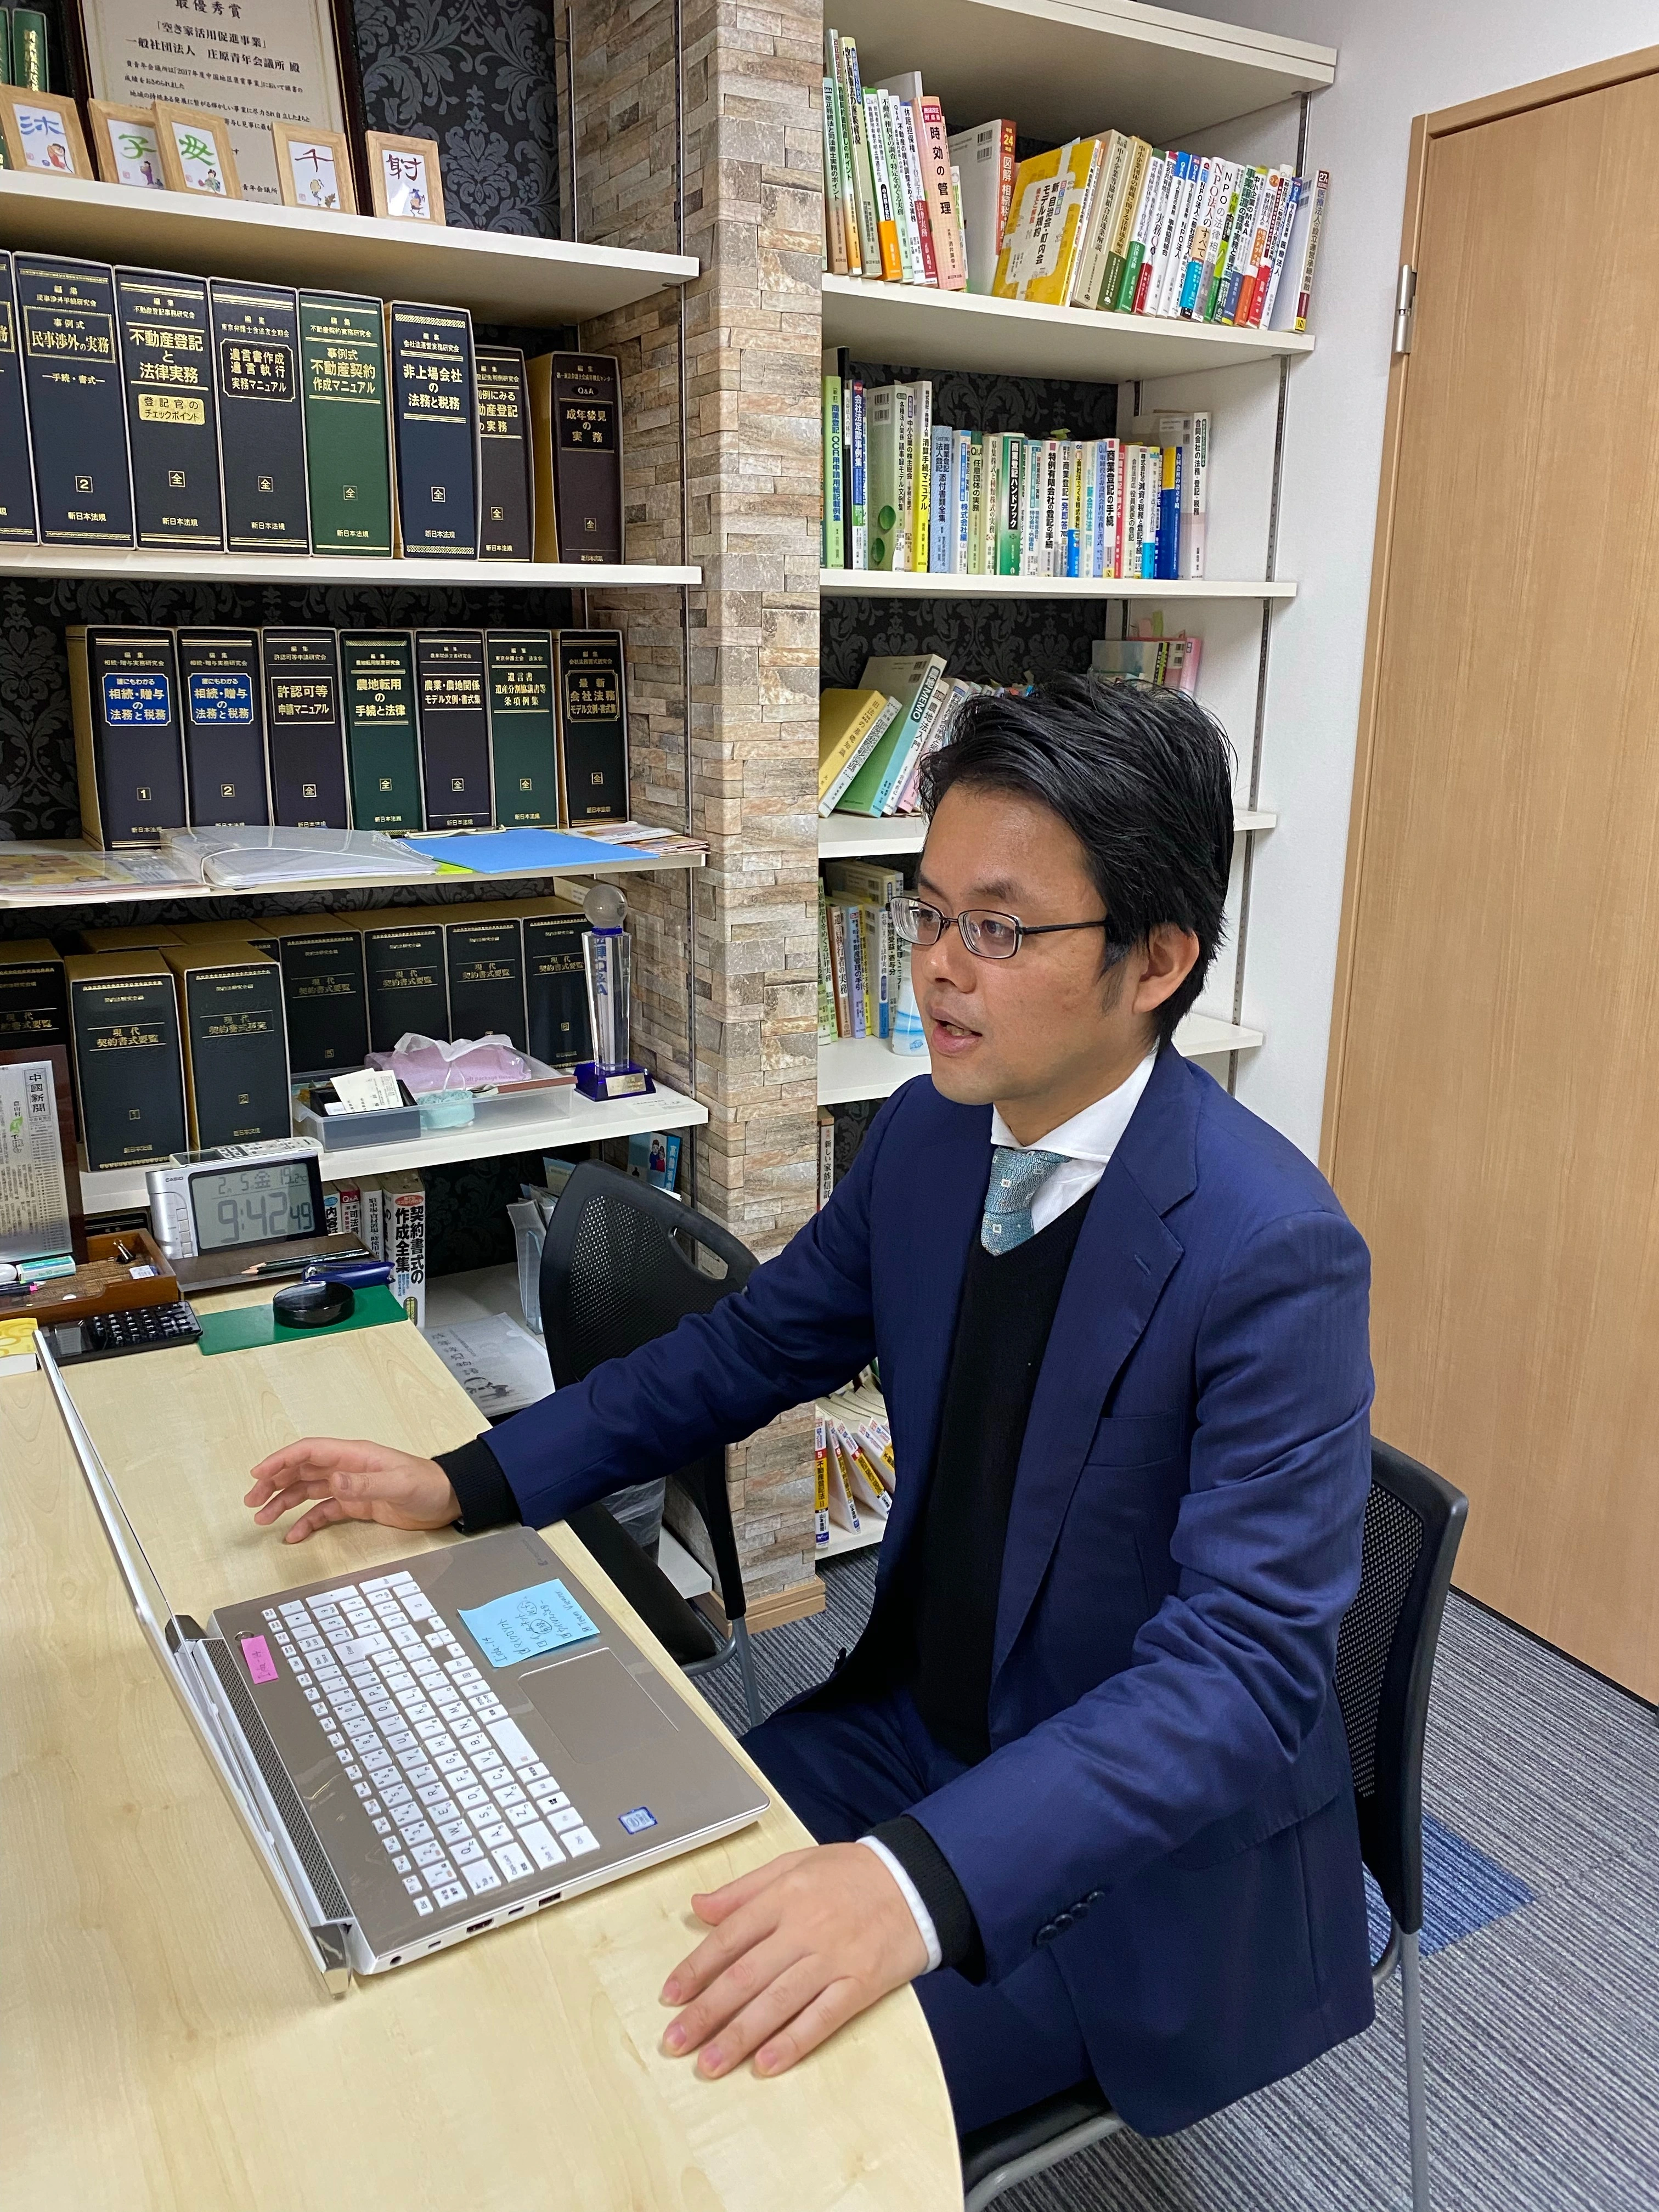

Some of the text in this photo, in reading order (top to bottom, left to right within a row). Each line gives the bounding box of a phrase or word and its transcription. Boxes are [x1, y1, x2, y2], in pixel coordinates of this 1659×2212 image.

[125, 37, 195, 57] 一般社団法人
[207, 49, 285, 71] 庄原青年会議所
[930, 126, 952, 215] 時効の管理
[1003, 157, 1012, 182] 図解
[1175, 222, 1187, 259] NPO法人
[1274, 241, 1287, 276] 医療法人
[54, 318, 85, 329] 事例式
[32, 330, 109, 354] 民事渉外の実務
[130, 329, 204, 351] 不動産登記
[163, 351, 174, 363] と
[230, 348, 285, 364] 遺言書作成
[328, 347, 358, 360] 事例式
[140, 363, 199, 383] 法律実務
[230, 362, 285, 379] 遺言執行
[311, 359, 375, 379] 不動産契約
[403, 364, 462, 382] 非上場会社
[232, 378, 287, 392] 実務マニュアル
[313, 377, 375, 394] 作成マニュアル
[428, 382, 439, 393] の
[144, 397, 198, 410] 登記官の
[408, 395, 460, 410] 法務と税務
[145, 409, 200, 422] チェックポイント
[567, 409, 606, 421] 成年後見
[573, 431, 603, 443] 実務
[921, 438, 929, 511] 清算手続マニュアル
[972, 459, 980, 512] 任意団体の実務
[1009, 443, 1019, 528] 商業登記ハンドブック
[1106, 450, 1115, 527] 商業登記の手続
[1045, 453, 1056, 549] 特例有限会社の登記の手続
[68, 512, 106, 522] 新日本法規
[162, 517, 199, 527] 新日本法規
[251, 521, 285, 531] 新日本法規
[337, 529, 369, 538] 新日本法規
[425, 530, 455, 539] 新日本法規
[507, 673, 533, 682] 遺言書
[277, 685, 328, 698] 許認可等
[357, 679, 402, 691] 農地転用
[425, 680, 480, 691] 農業・農地関係
[495, 684, 546, 694] 遺産分割協議書等
[109, 689, 165, 700] 相続・贈与
[194, 689, 248, 699] 相続・贈与
[375, 693, 385, 702] の
[425, 693, 481, 704] モデル文例・書式集
[571, 691, 615, 702] 会社法務
[504, 697, 539, 706] 条項例集
[111, 709, 166, 720] 法務と税務
[195, 708, 249, 719] 法務と税務
[278, 704, 329, 715] 申請マニュアル
[356, 705, 406, 716] 手続と法律
[571, 704, 617, 714] モデル文例・書式集
[911, 702, 938, 752] 農地法入門
[224, 1015, 249, 1023] 現代
[112, 1027, 140, 1036] 現代
[29, 1074, 46, 1113] 中國新聞
[823, 1140, 832, 1199] 新しい家族信託
[217, 1192, 312, 1243] 9:42 49
[395, 1207, 410, 1273] 作成全集
[410, 1206, 424, 1284] 契約書式の
